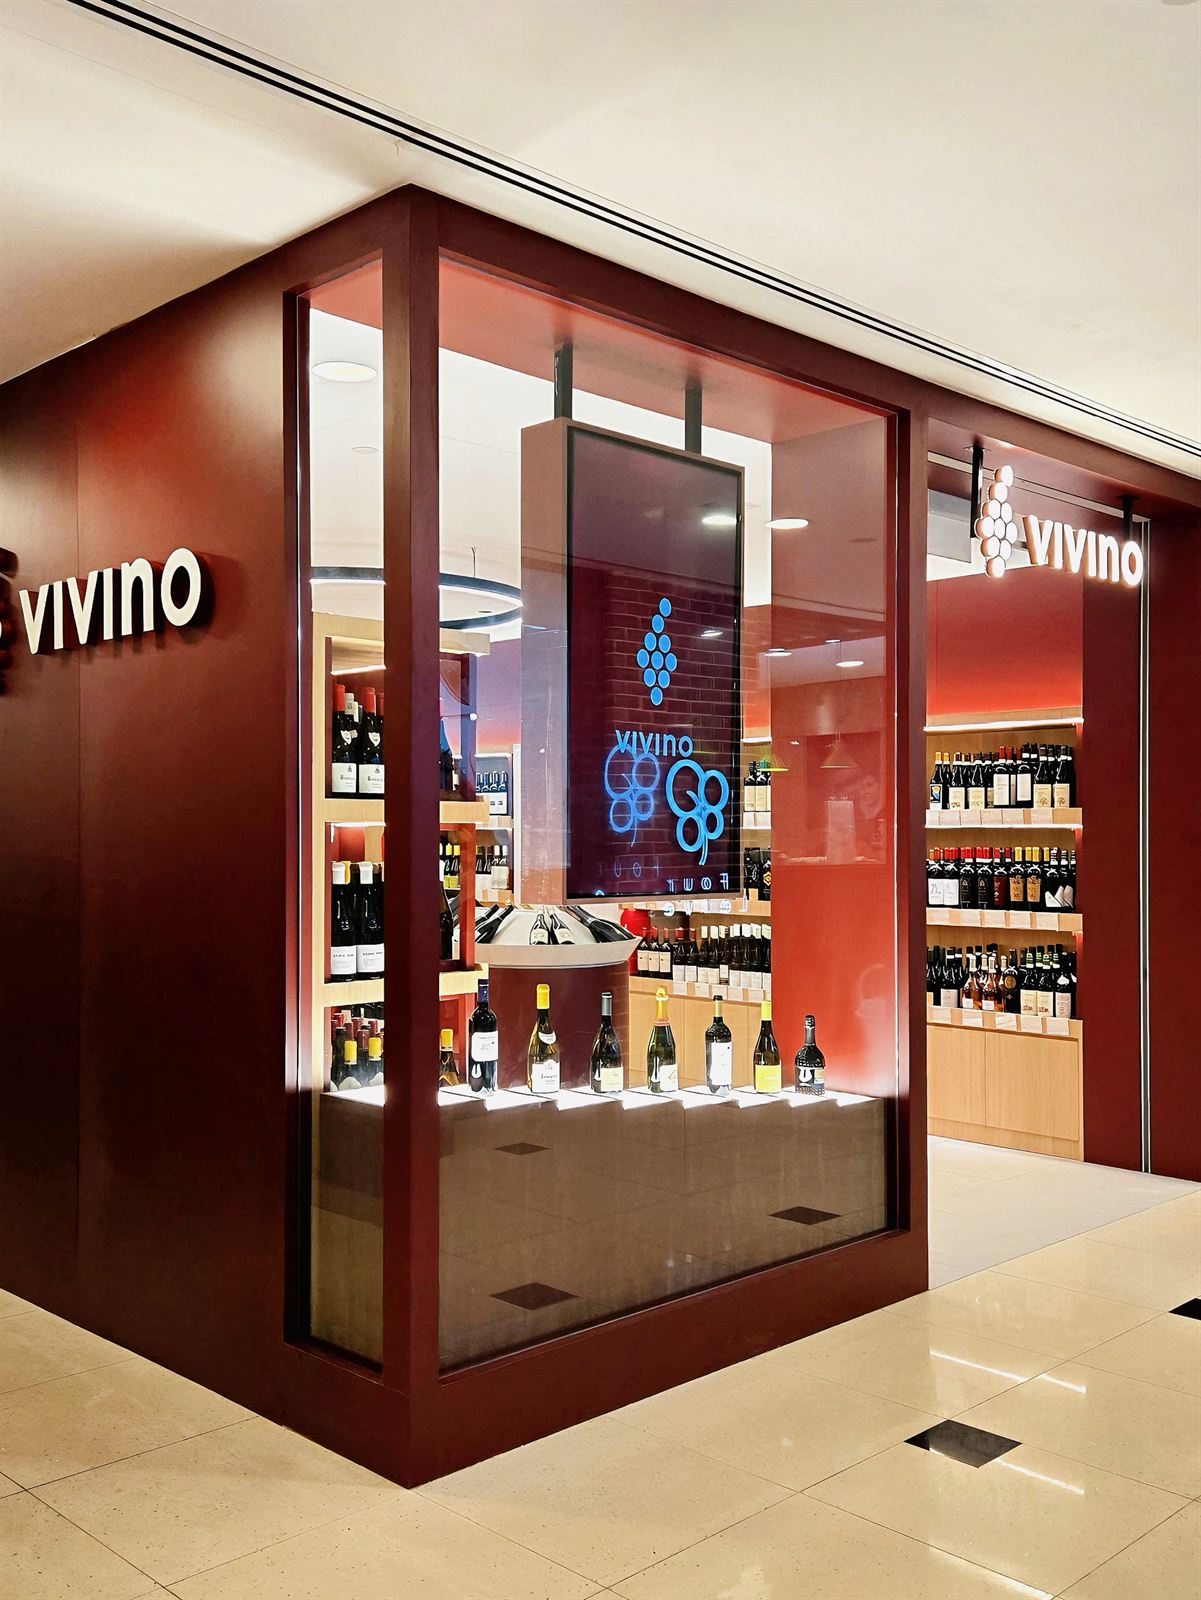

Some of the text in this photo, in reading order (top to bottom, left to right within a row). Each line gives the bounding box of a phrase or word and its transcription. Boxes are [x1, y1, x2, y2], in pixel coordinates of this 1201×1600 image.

[1024, 515, 1144, 586] vivino
[19, 547, 202, 655] vivino
[615, 730, 693, 757] vivino
